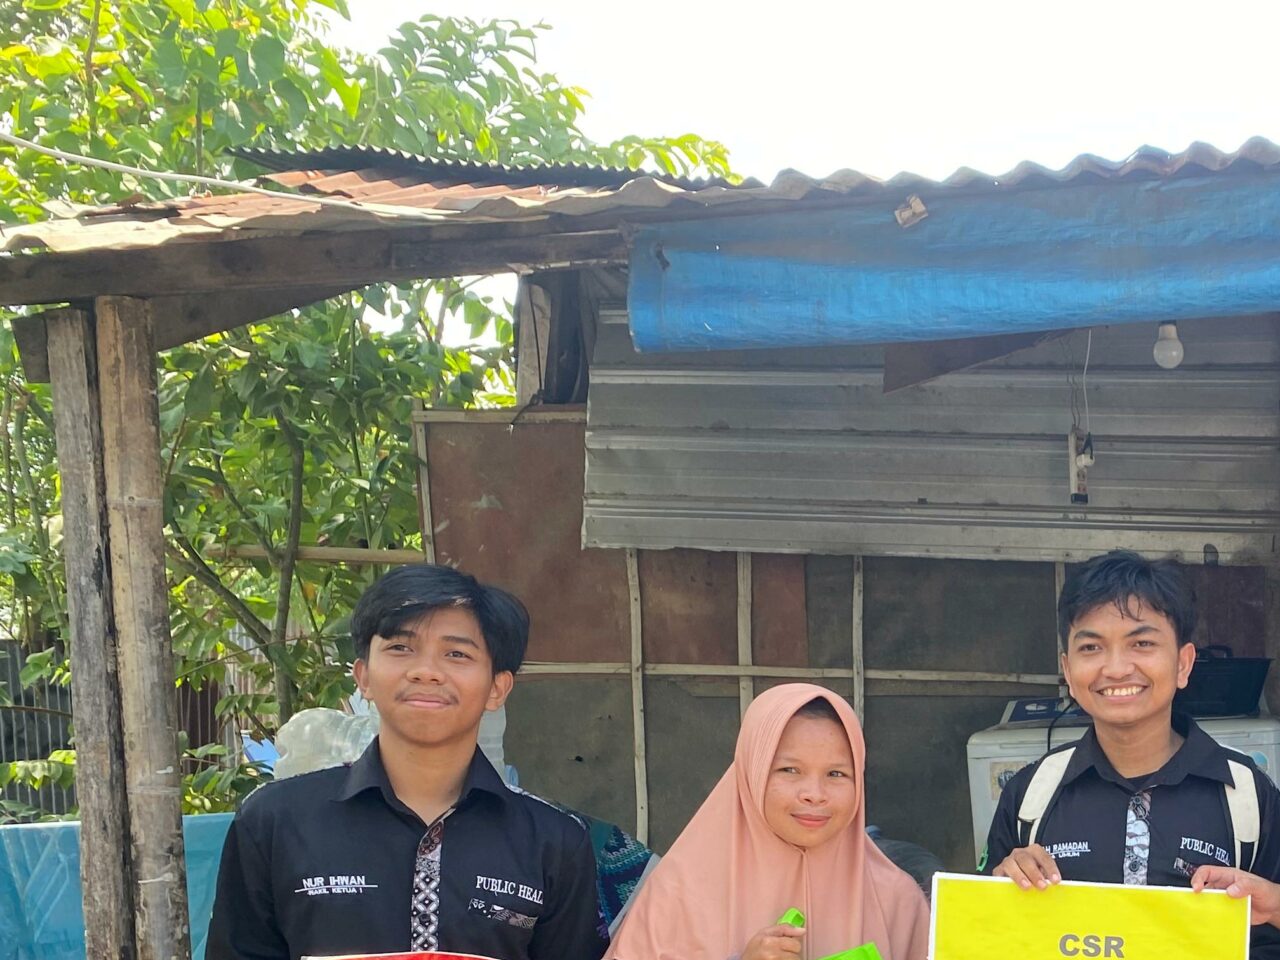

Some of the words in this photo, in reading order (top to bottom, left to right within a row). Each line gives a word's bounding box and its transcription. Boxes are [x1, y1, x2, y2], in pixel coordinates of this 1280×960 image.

[1053, 842, 1088, 853] RAMADAN
[1180, 836, 1215, 856] PUBLIC
[302, 876, 324, 889] NUR
[329, 875, 366, 886] IHWAN
[475, 875, 516, 896] PUBLIC
[1059, 934, 1125, 959] CSR
